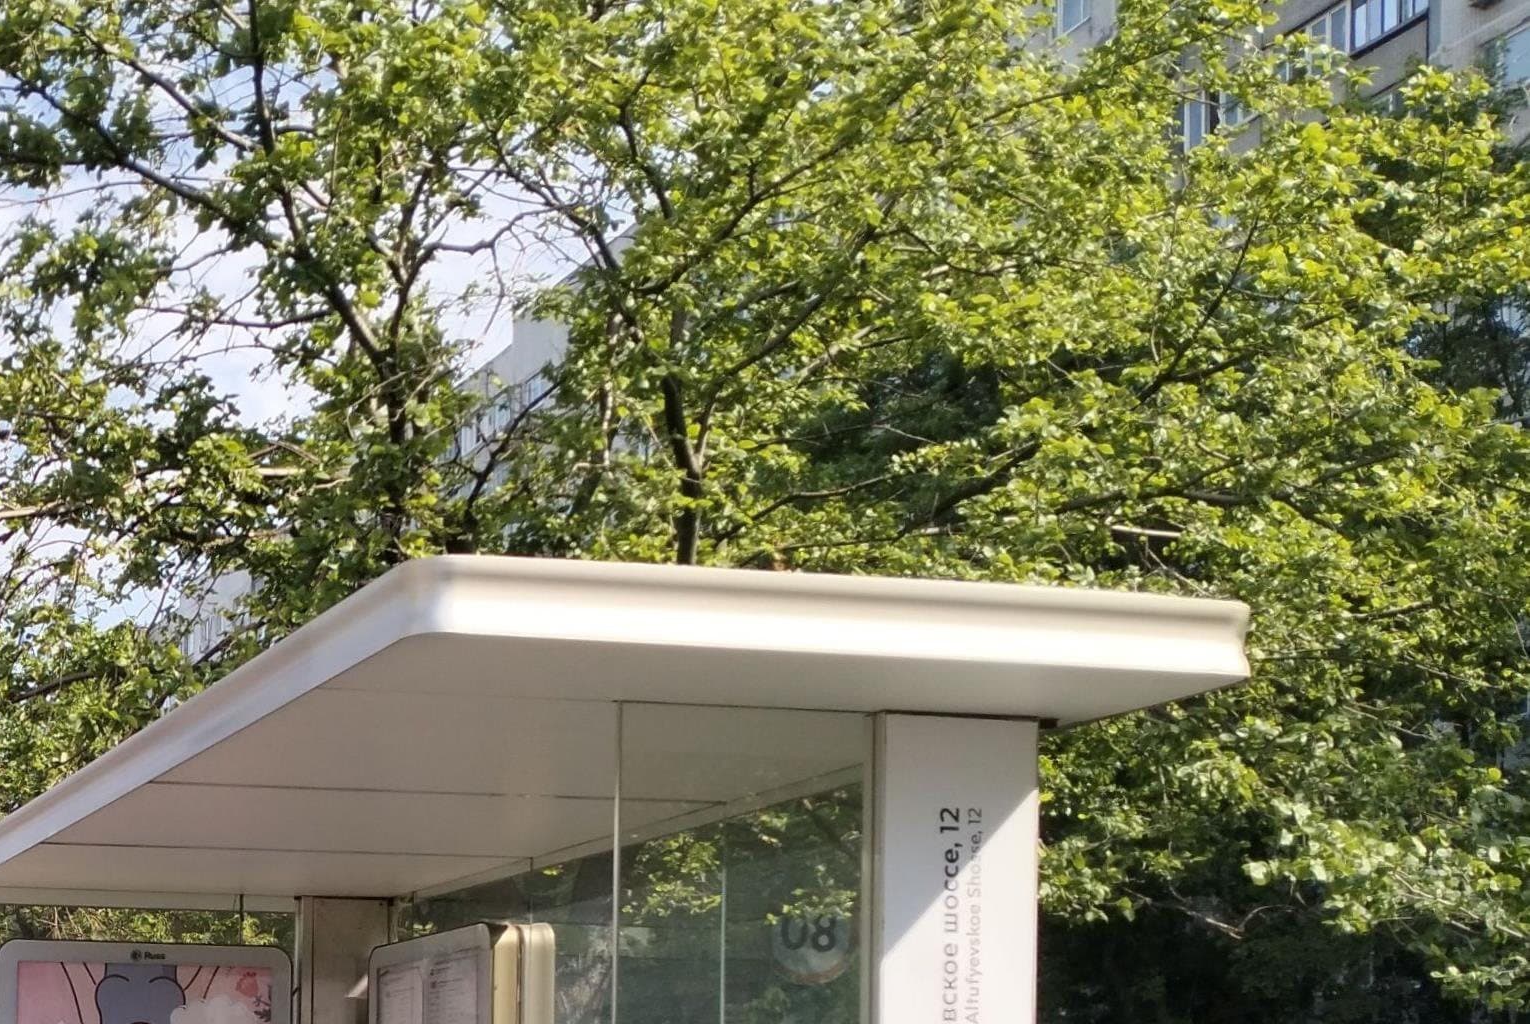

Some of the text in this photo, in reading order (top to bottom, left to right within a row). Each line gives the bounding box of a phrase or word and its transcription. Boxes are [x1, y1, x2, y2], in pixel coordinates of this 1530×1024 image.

[939, 806, 960, 834] 12
[968, 807, 982, 824] 12
[944, 842, 963, 934] шоссе,
[964, 903, 984, 1024] Altufyevskoe
